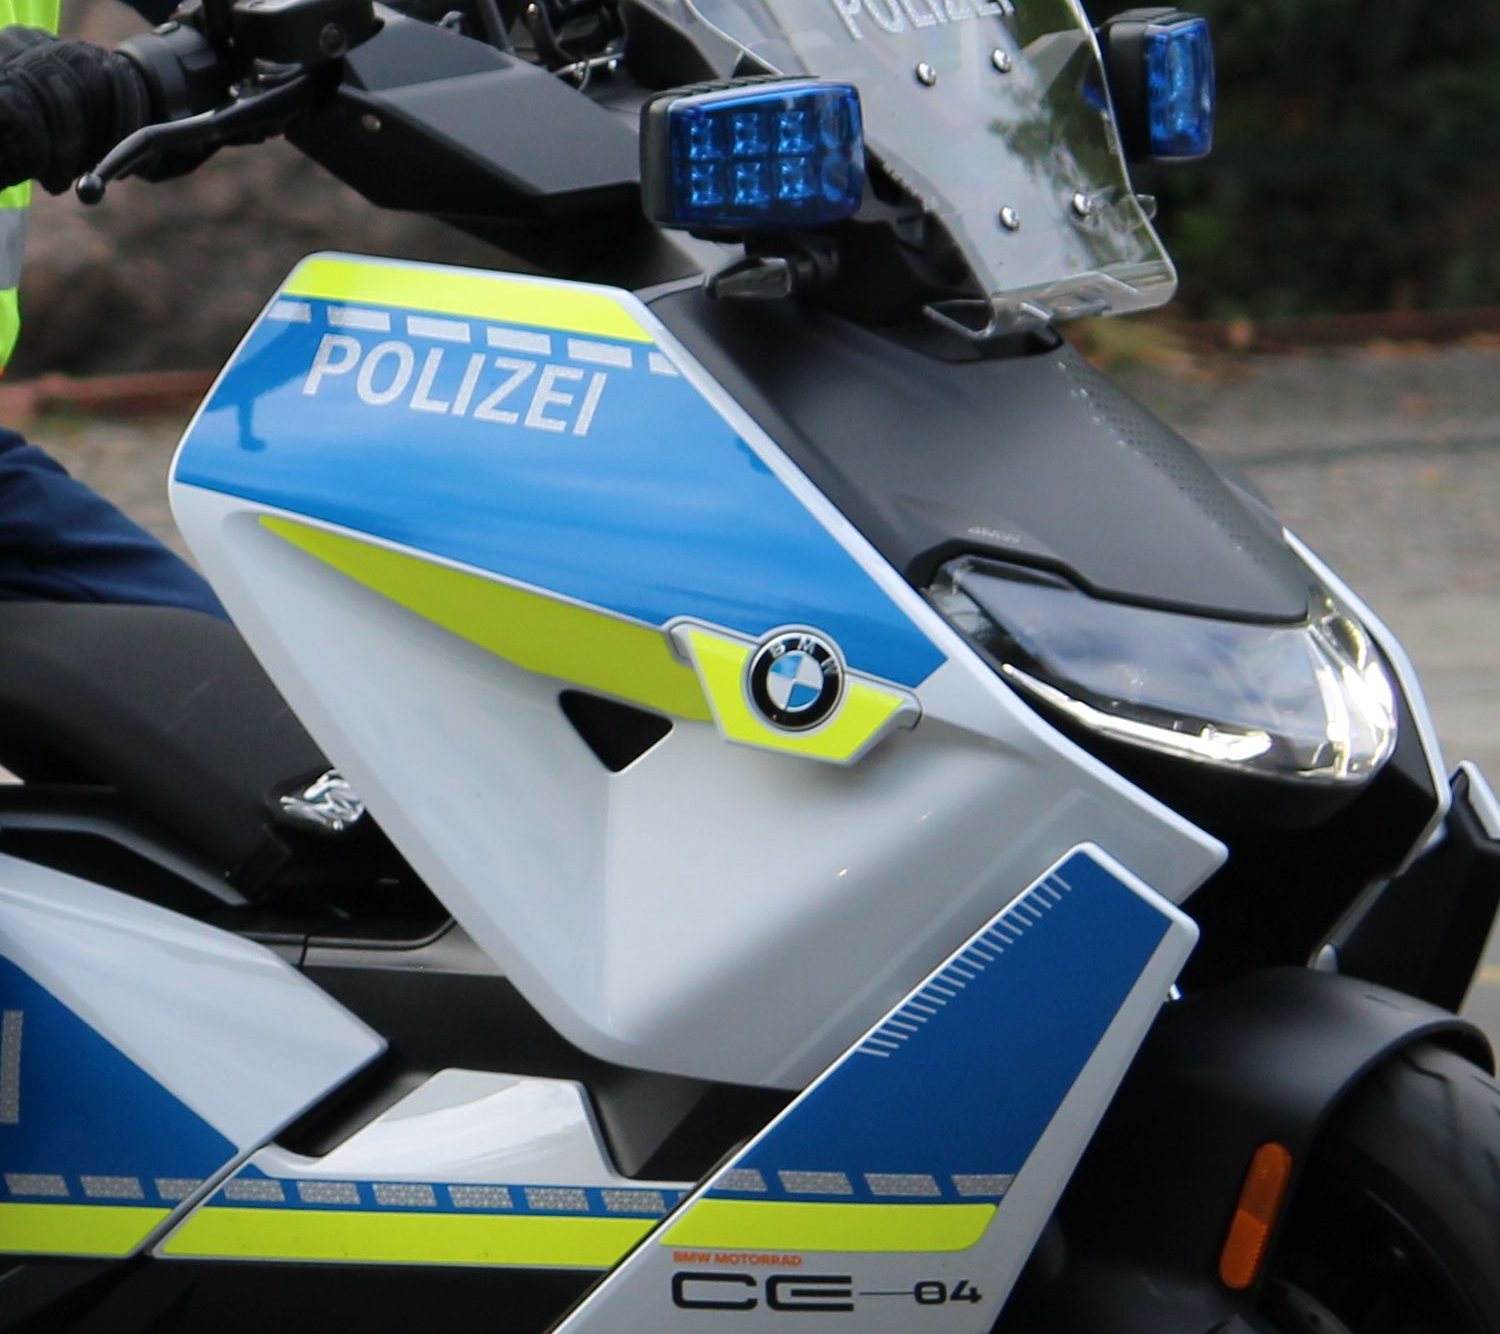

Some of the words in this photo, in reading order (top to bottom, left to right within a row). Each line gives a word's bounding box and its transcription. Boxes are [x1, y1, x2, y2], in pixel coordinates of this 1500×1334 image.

[302, 333, 607, 438] POLIZEI
[769, 635, 839, 674] BMW
[673, 1250, 710, 1265] BMW
[714, 1252, 803, 1267] MOTORRAD
